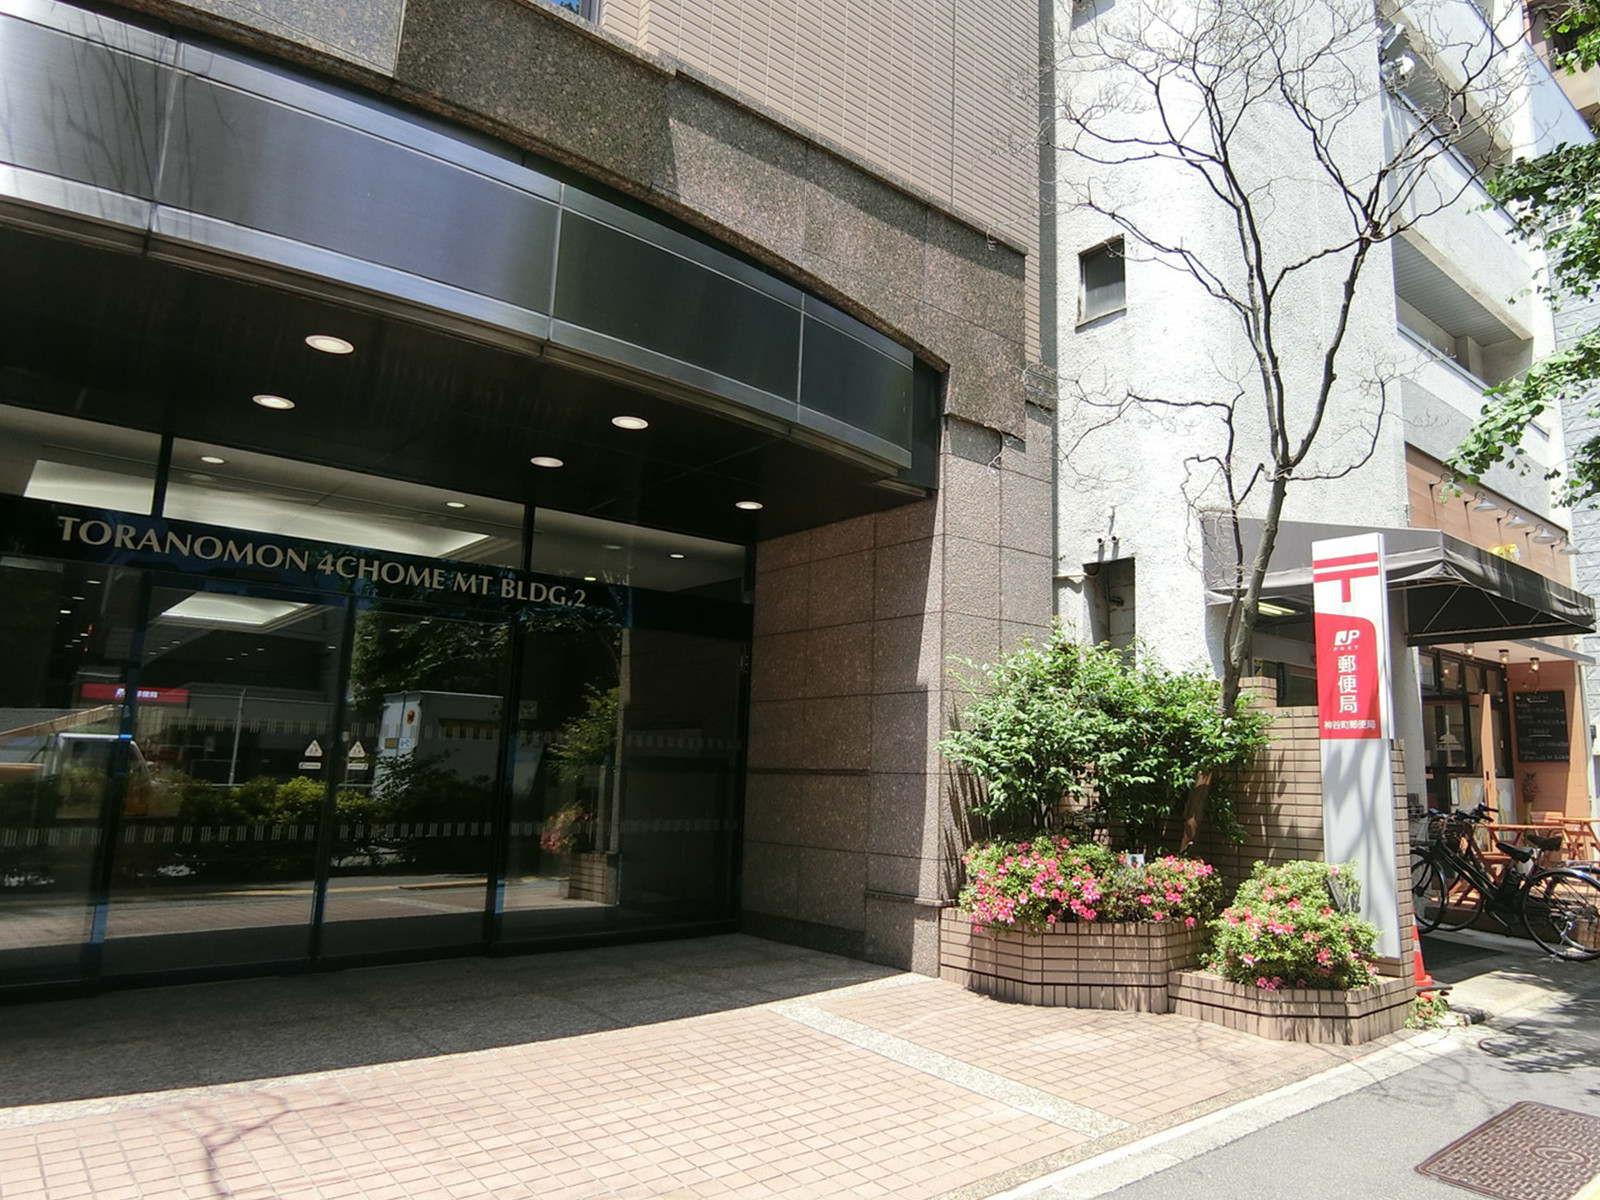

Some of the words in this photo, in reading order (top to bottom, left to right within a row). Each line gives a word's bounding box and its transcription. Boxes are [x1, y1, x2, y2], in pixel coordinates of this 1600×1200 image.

[57, 515, 309, 572] TORANOMON
[317, 553, 446, 590] 4CHOME
[453, 572, 493, 596] MT
[500, 578, 587, 608] BLDG.2
[1334, 629, 1360, 646] JP
[1337, 654, 1358, 714] 郵便局
